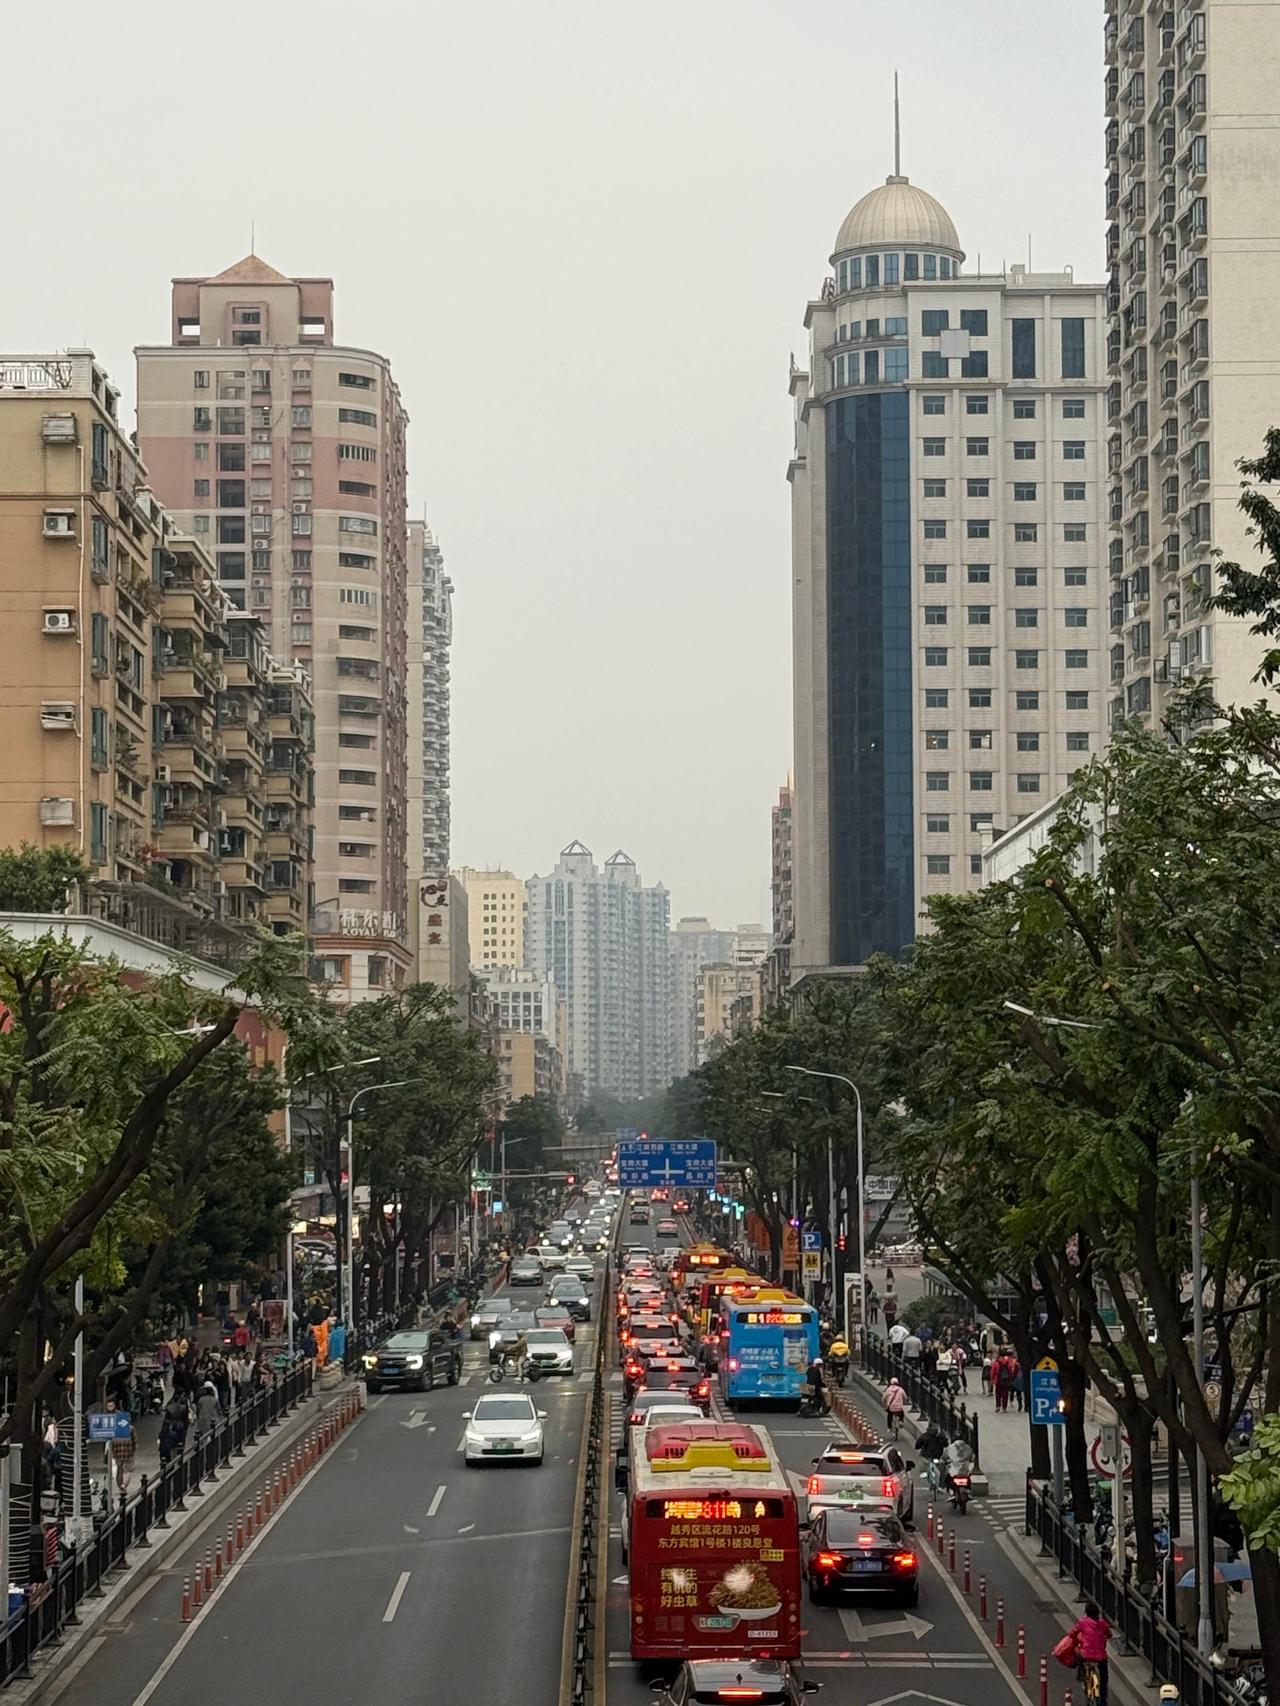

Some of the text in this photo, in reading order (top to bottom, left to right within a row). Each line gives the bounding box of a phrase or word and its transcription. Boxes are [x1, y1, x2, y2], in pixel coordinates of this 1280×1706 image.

[343, 928, 377, 937] ROYAL
[803, 1234, 815, 1249] P
[1035, 1398, 1050, 1417] P
[670, 1524, 760, 1536] 越秀区流花路120号
[660, 1595, 698, 1608] 好虫草
